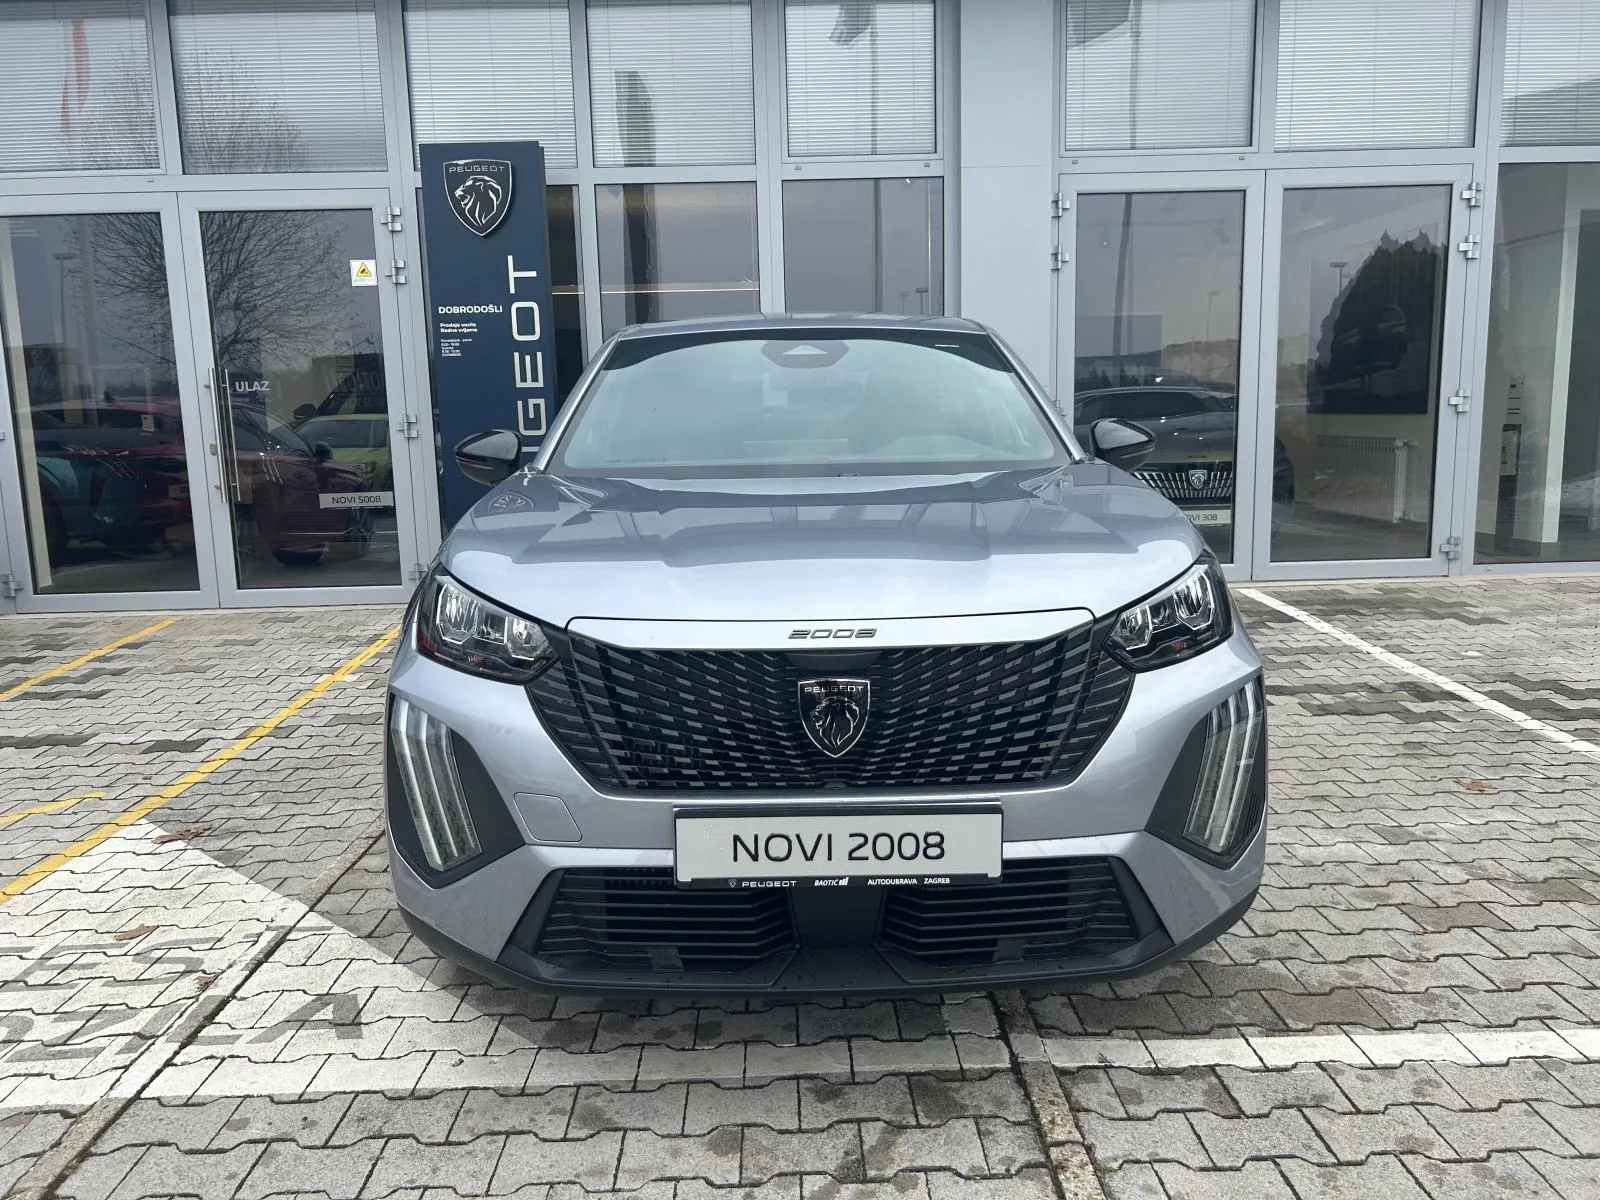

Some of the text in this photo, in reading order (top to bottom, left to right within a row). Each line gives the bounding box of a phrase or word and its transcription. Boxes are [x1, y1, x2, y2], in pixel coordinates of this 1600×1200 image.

[448, 165, 505, 173] PEUGEOT
[438, 303, 503, 314] DOBRODOŠLI
[507, 254, 547, 452] GEOT
[235, 380, 270, 392] ULAZ
[332, 495, 382, 505] NOVI 5008
[788, 628, 878, 640] 2008
[804, 685, 864, 694] PEUGEOT
[732, 831, 946, 862] NOVI 2008
[741, 880, 798, 888] PEUGEOT
[867, 877, 951, 886] AUTODUBRAVA ZAGREB
[0, 924, 335, 992] EST
